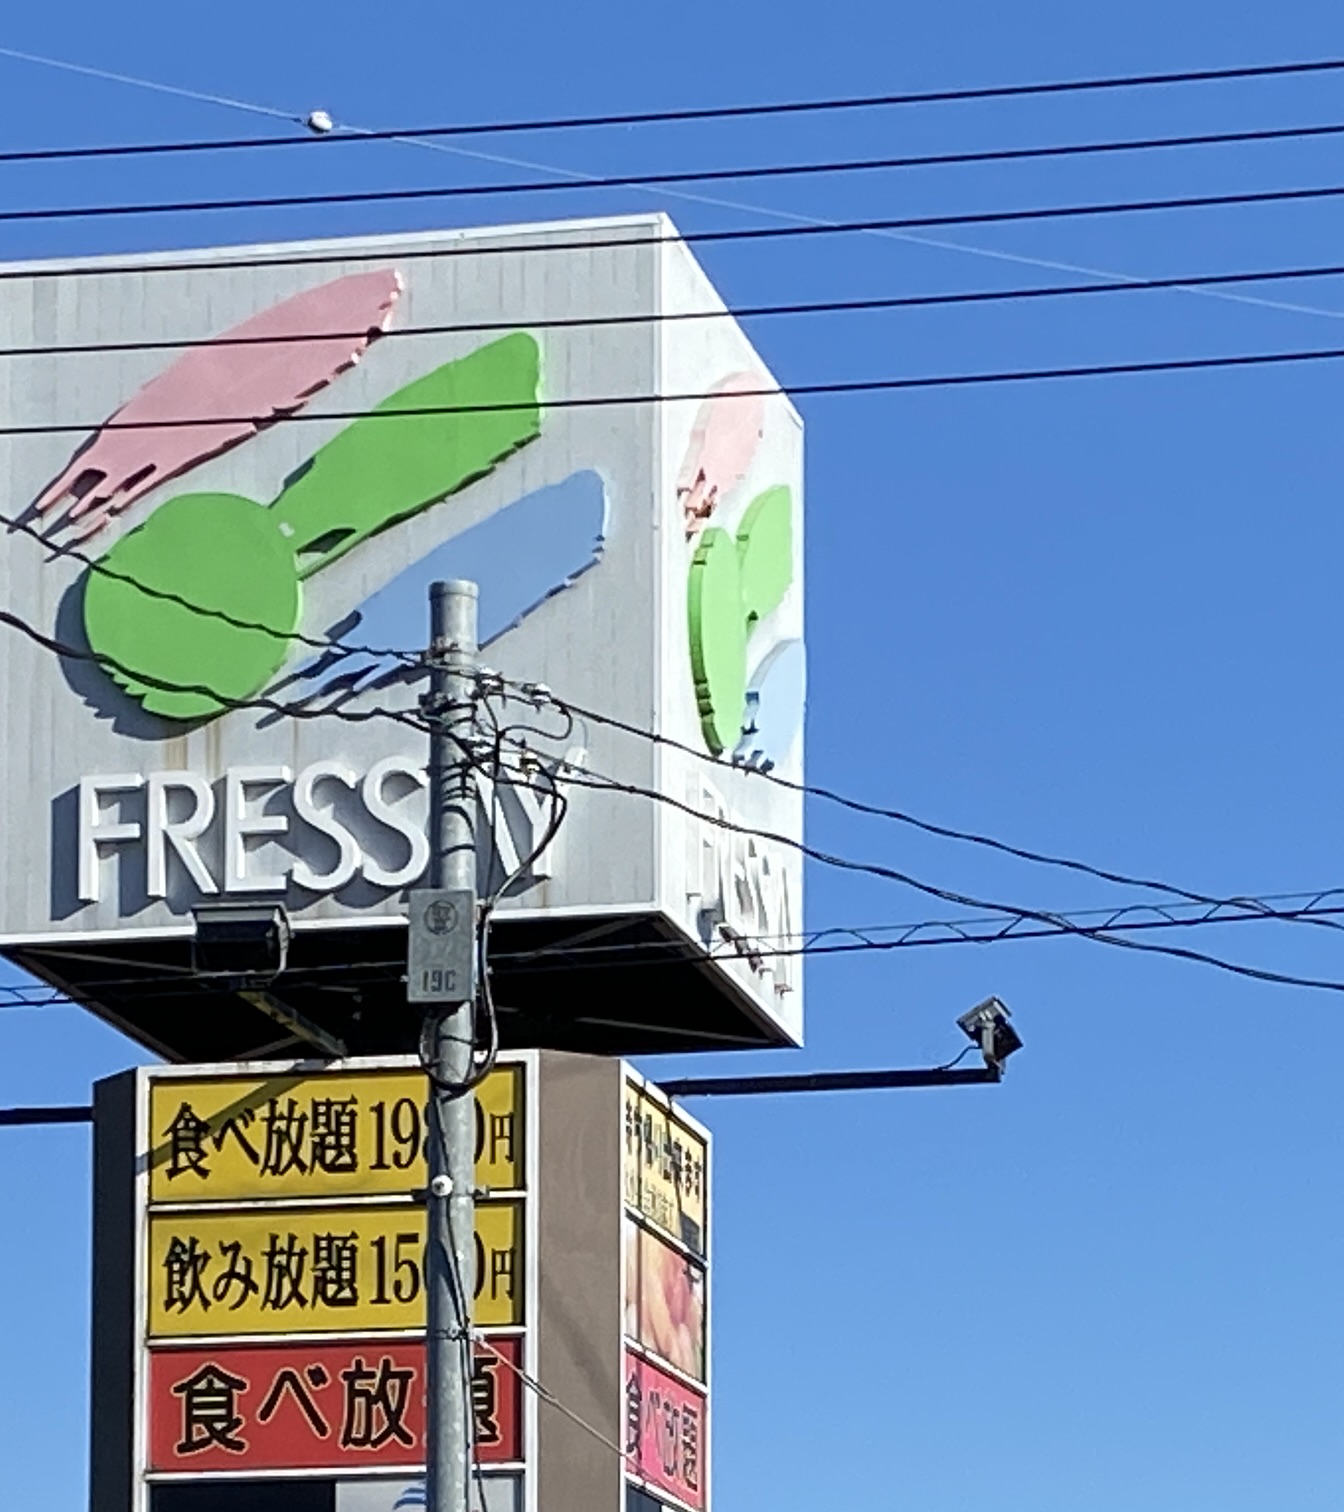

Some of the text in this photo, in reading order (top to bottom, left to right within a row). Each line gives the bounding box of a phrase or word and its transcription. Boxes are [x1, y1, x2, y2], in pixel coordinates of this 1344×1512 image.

[162, 1096, 514, 1181] 食べ放題19円
[163, 1230, 514, 1313] 飲み放題15円
